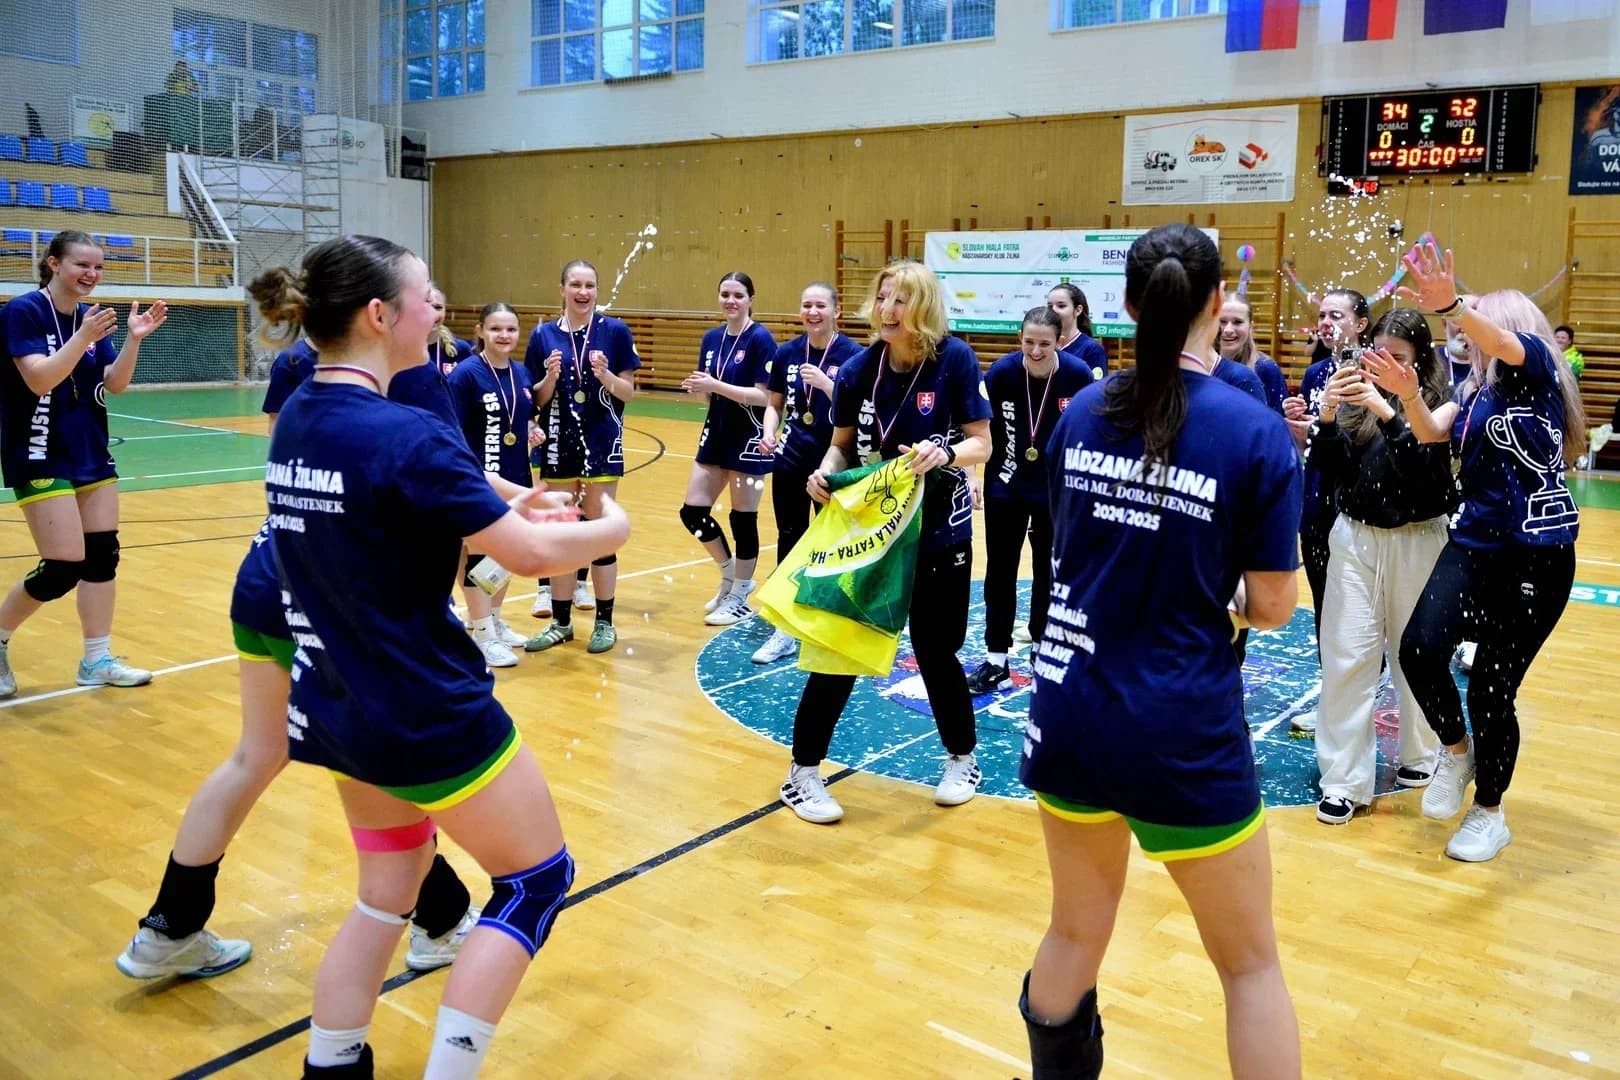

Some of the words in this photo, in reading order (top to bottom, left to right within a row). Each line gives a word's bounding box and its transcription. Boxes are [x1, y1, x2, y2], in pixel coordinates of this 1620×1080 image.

[1382, 103, 1408, 119] 34
[1376, 122, 1408, 131] DOMÁCI
[1420, 114, 1434, 133] 2
[1446, 119, 1477, 128] HOSTIA
[1379, 131, 1392, 149] 0
[1417, 139, 1435, 148] ČAS
[1461, 127, 1475, 145] 0
[1396, 147, 1456, 167] 30:00
[787, 364, 799, 383] SR
[483, 391, 500, 412] SR
[1002, 401, 1015, 421] SR
[858, 399, 876, 426] SR
[485, 414, 500, 472] STERKY
[294, 457, 345, 495] ŽILINA
[1064, 441, 1147, 483] HÁDZANÁ
[1146, 458, 1218, 502] ŽILINA
[1115, 486, 1215, 522] DORASTENIEK
[1093, 501, 1161, 531] 2024/2025
[875, 511, 902, 546] MALÁ
[837, 537, 875, 560] FATRA
